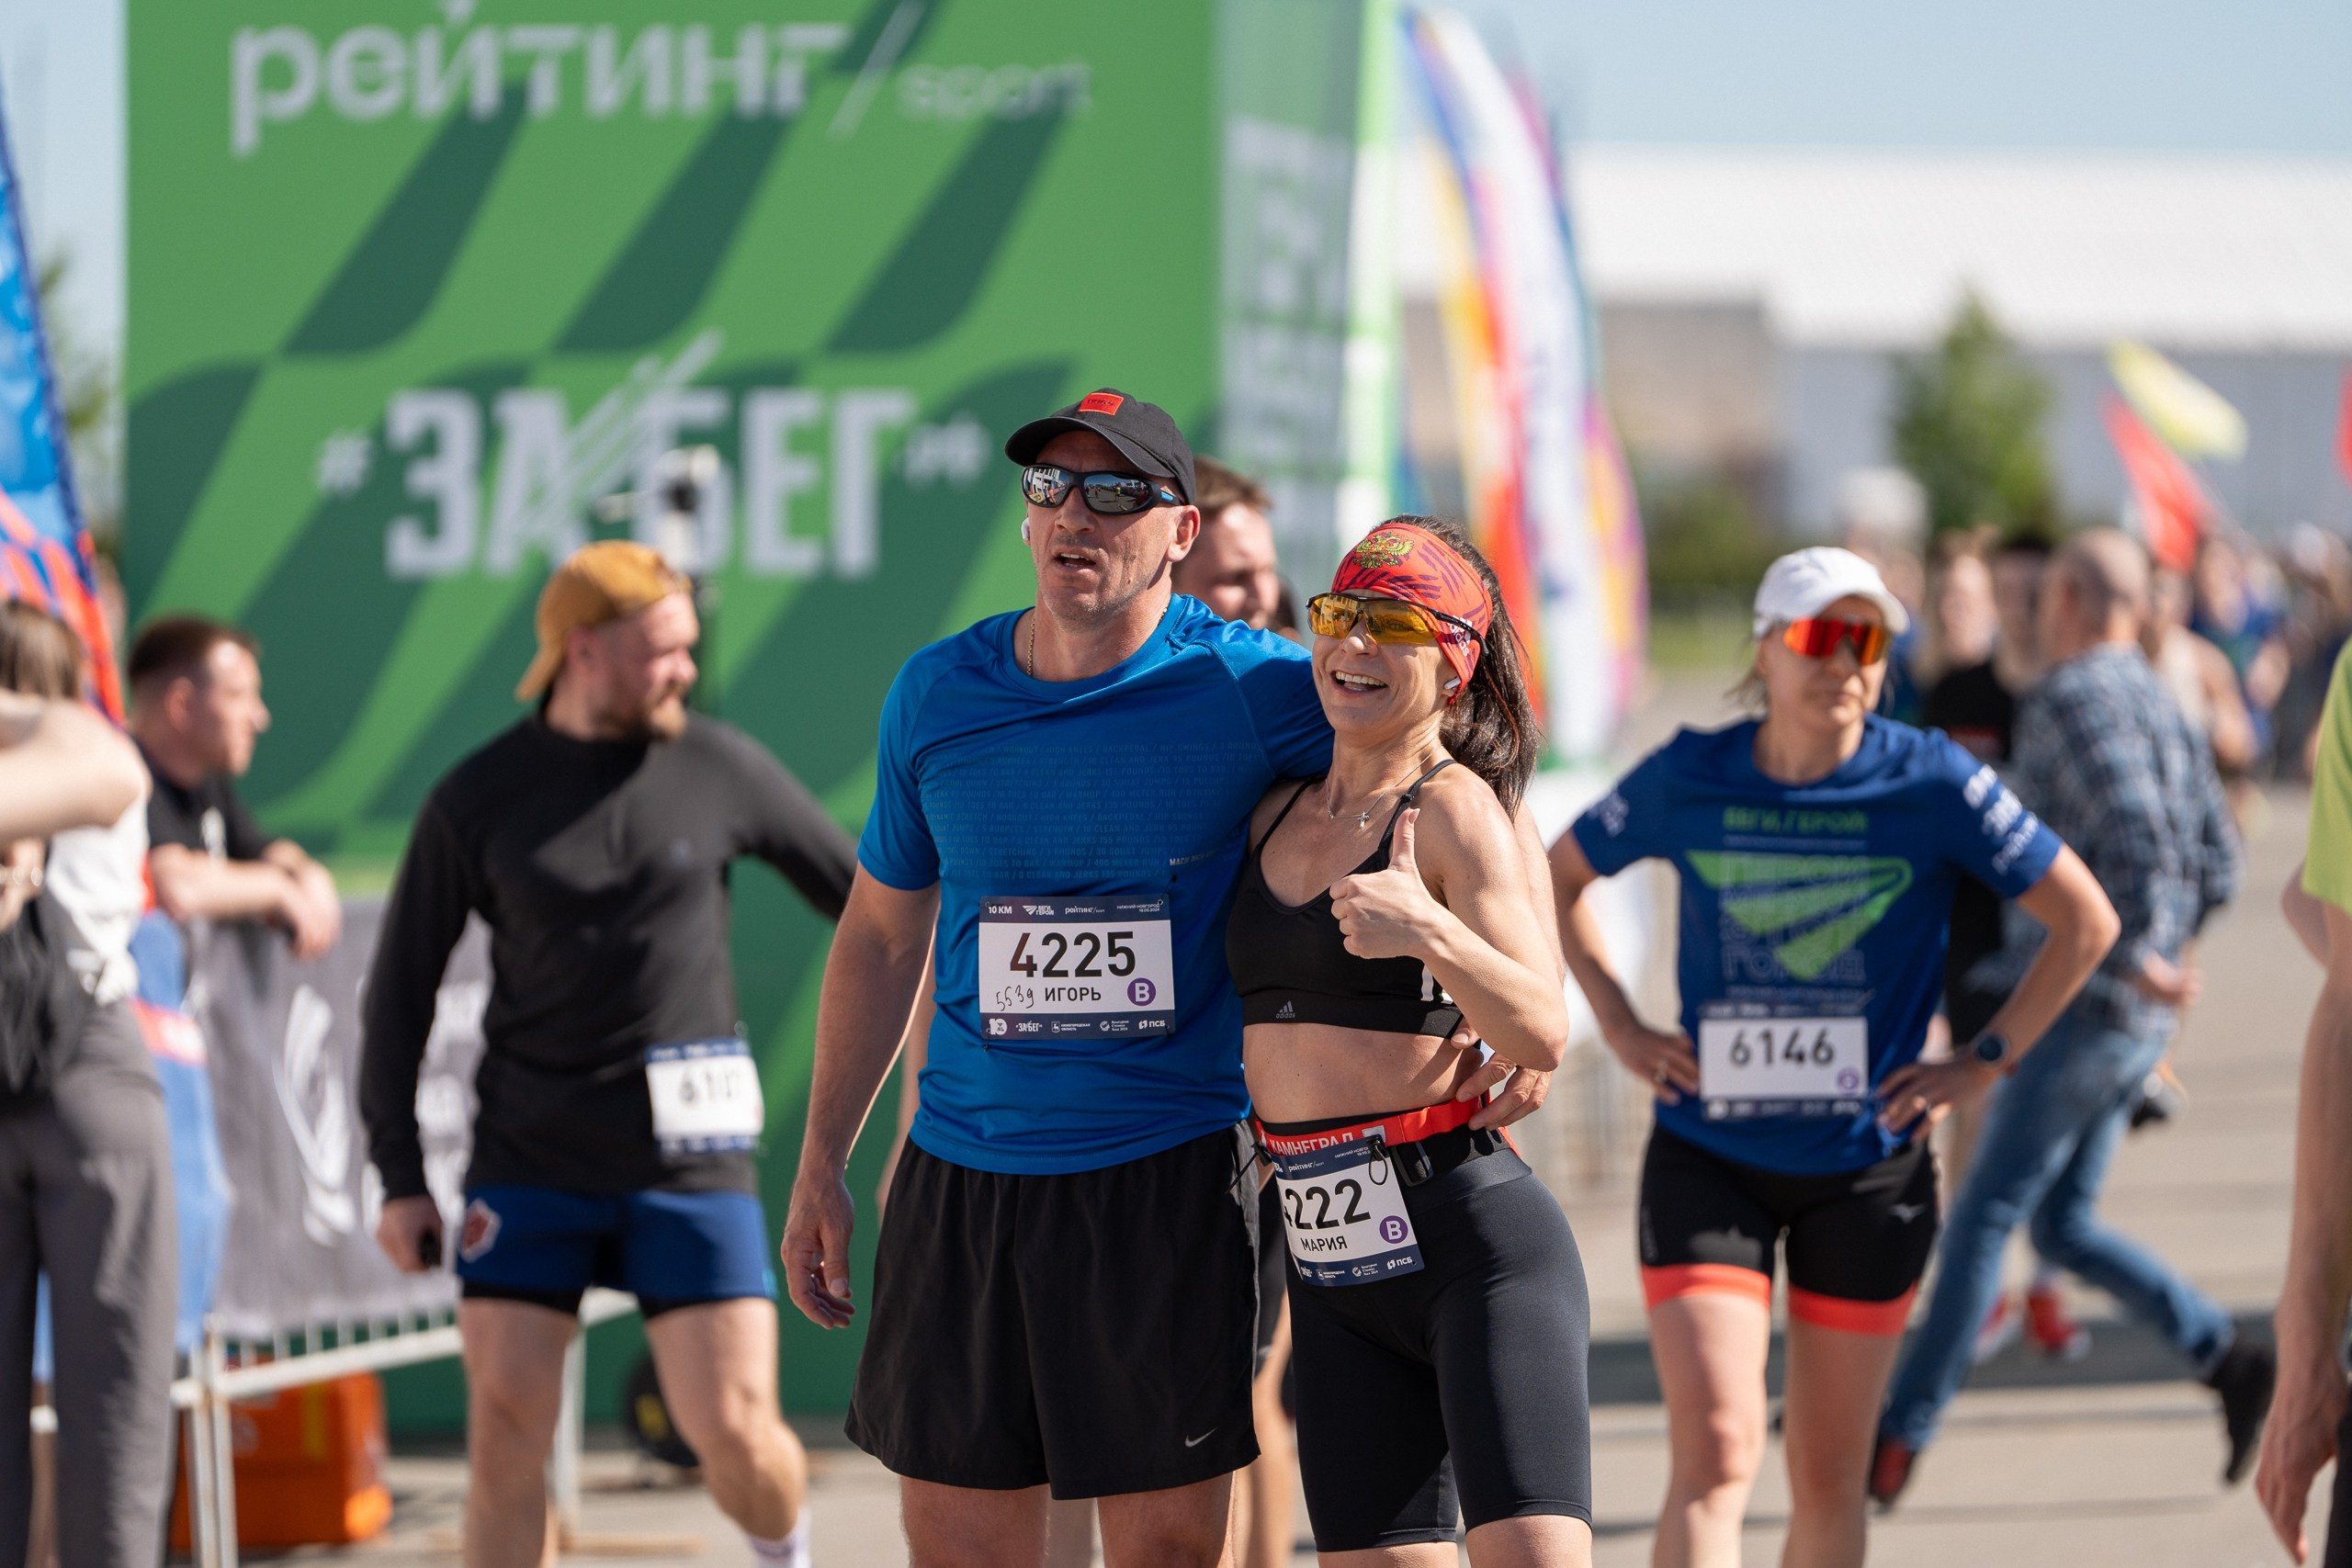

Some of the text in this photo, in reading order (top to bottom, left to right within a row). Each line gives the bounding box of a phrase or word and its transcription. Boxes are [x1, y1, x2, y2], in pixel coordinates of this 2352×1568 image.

[988, 906, 998, 914] 10
[1010, 931, 1136, 978] 4225
[1045, 987, 1102, 1002] ИГОРЬ
[1729, 1028, 1835, 1067] 6146
[1300, 1235, 1348, 1252] МАРИЯ
[1396, 1257, 1413, 1267] ПСБ
